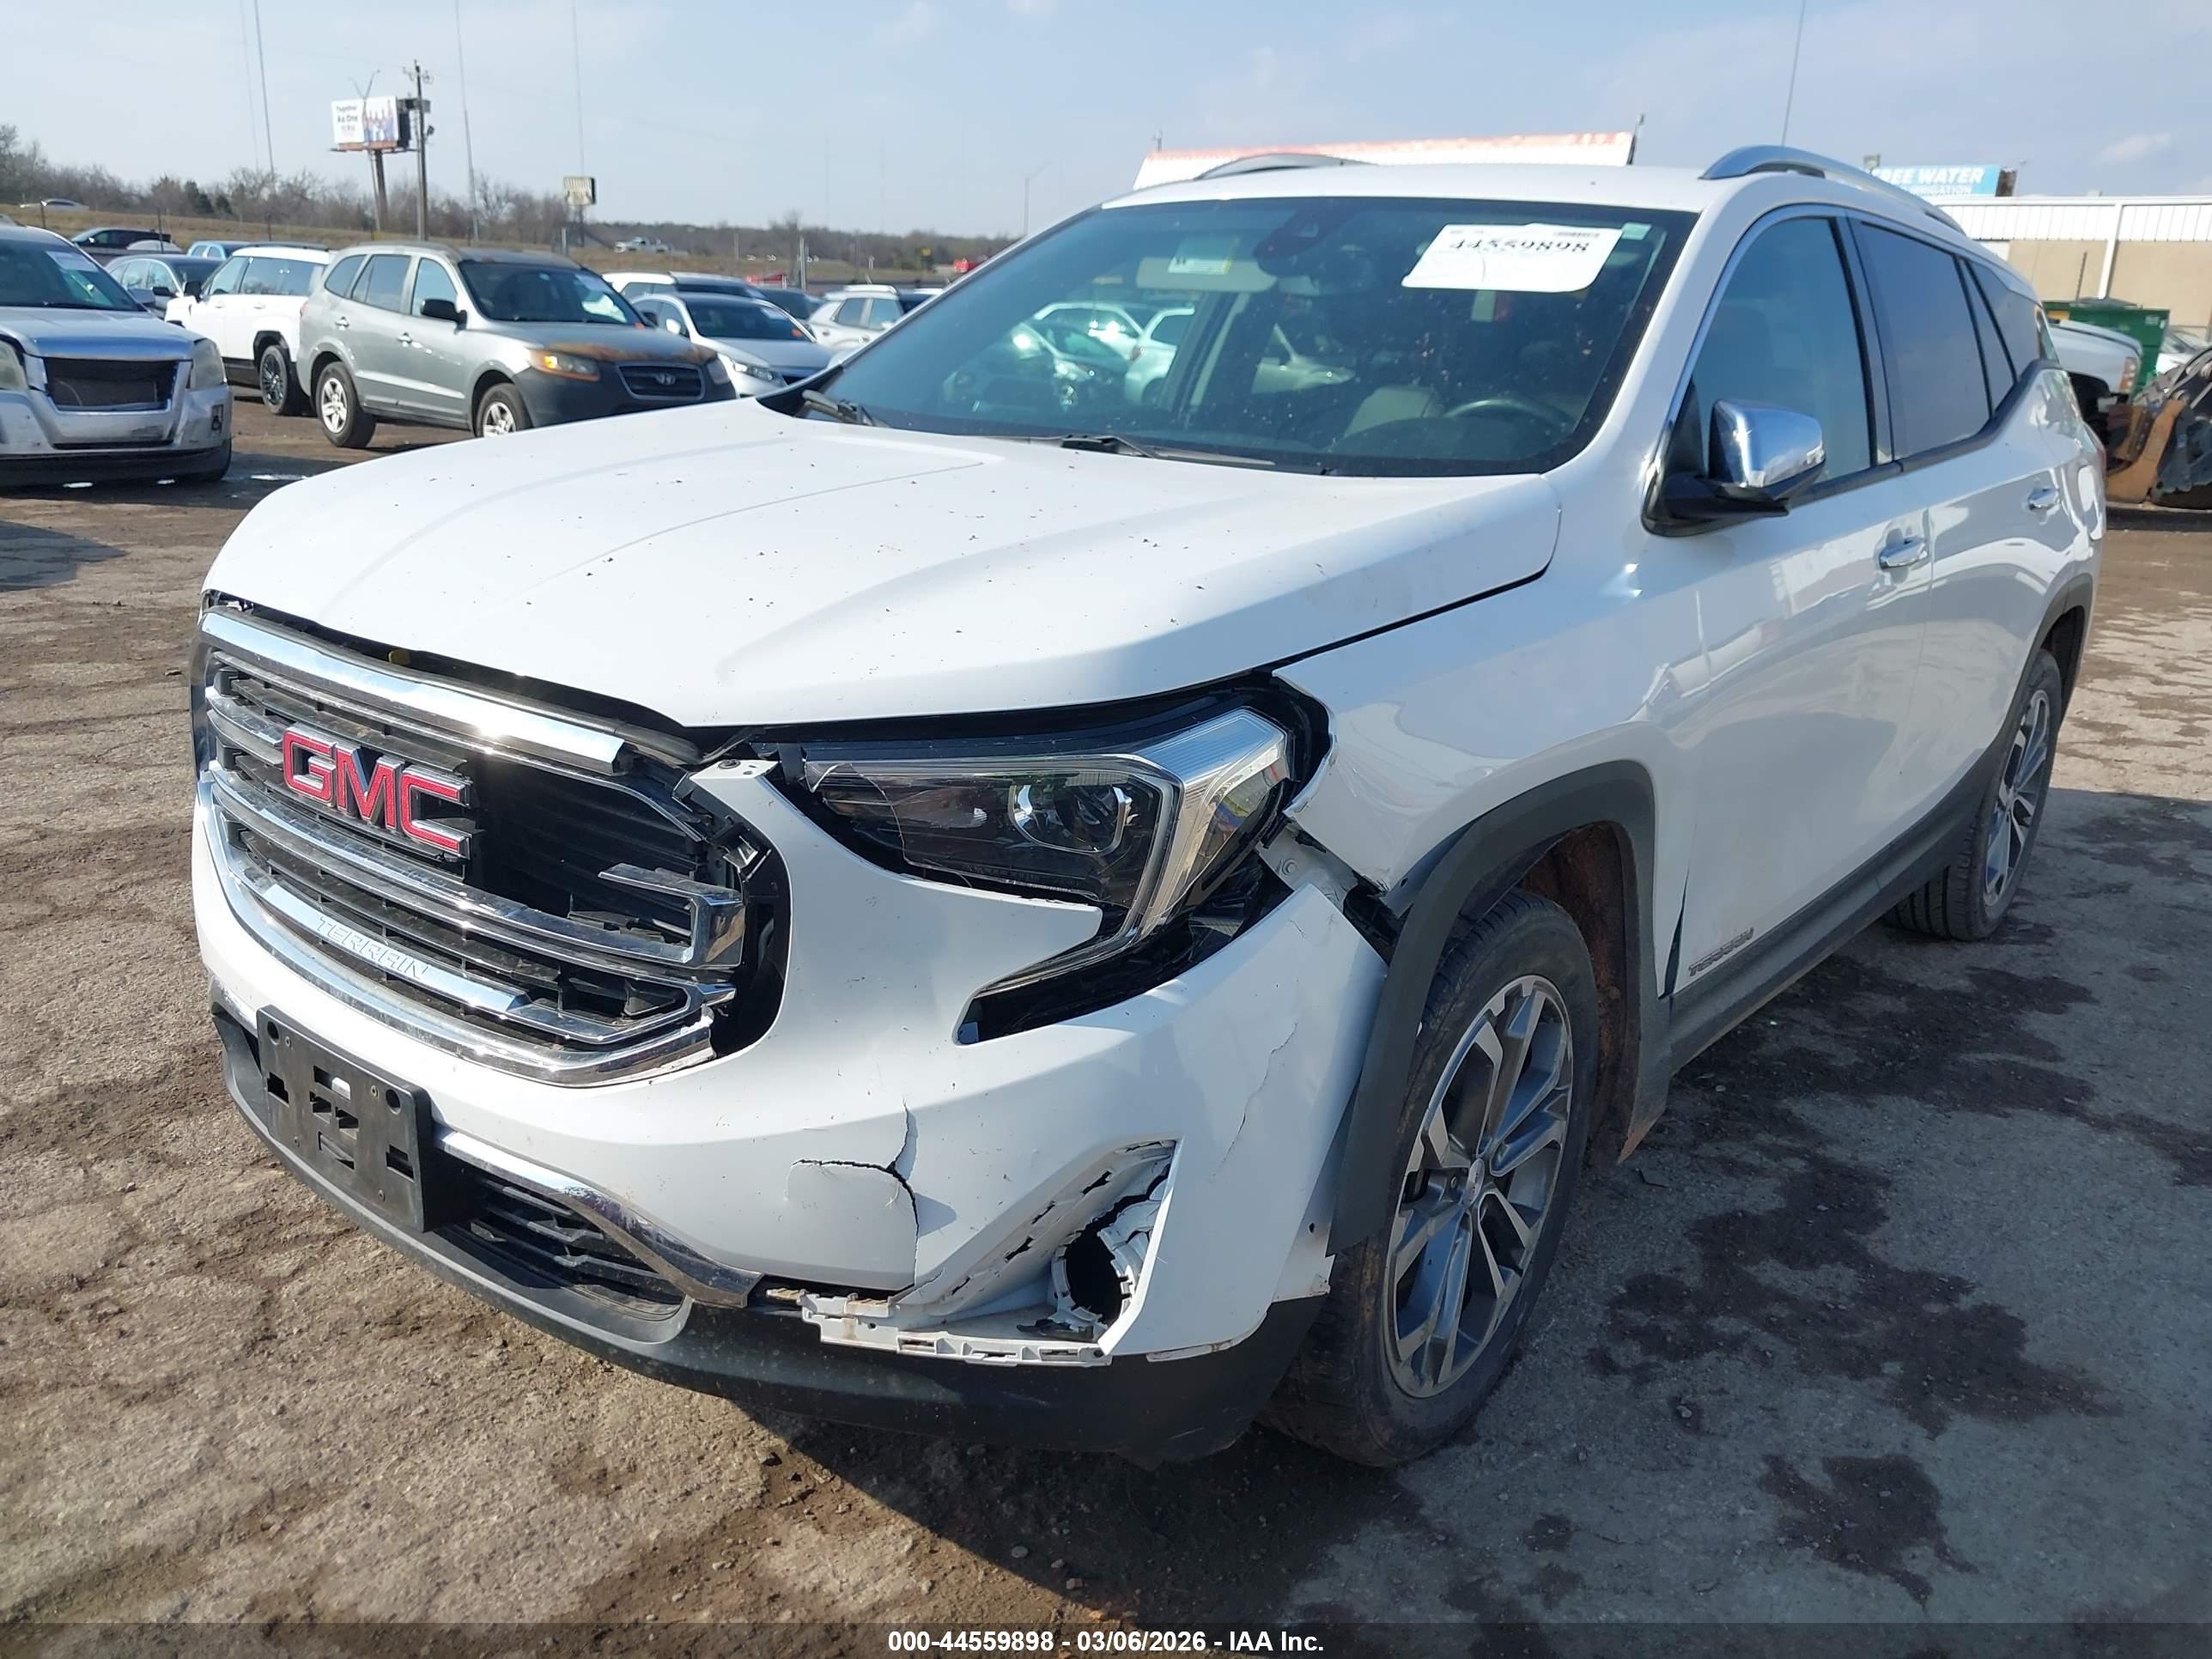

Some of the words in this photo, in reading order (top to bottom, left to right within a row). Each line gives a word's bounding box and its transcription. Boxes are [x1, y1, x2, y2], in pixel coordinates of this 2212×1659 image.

[1918, 167, 1985, 184] WATER
[283, 724, 473, 860] GMC
[316, 915, 429, 980] TERRAIN
